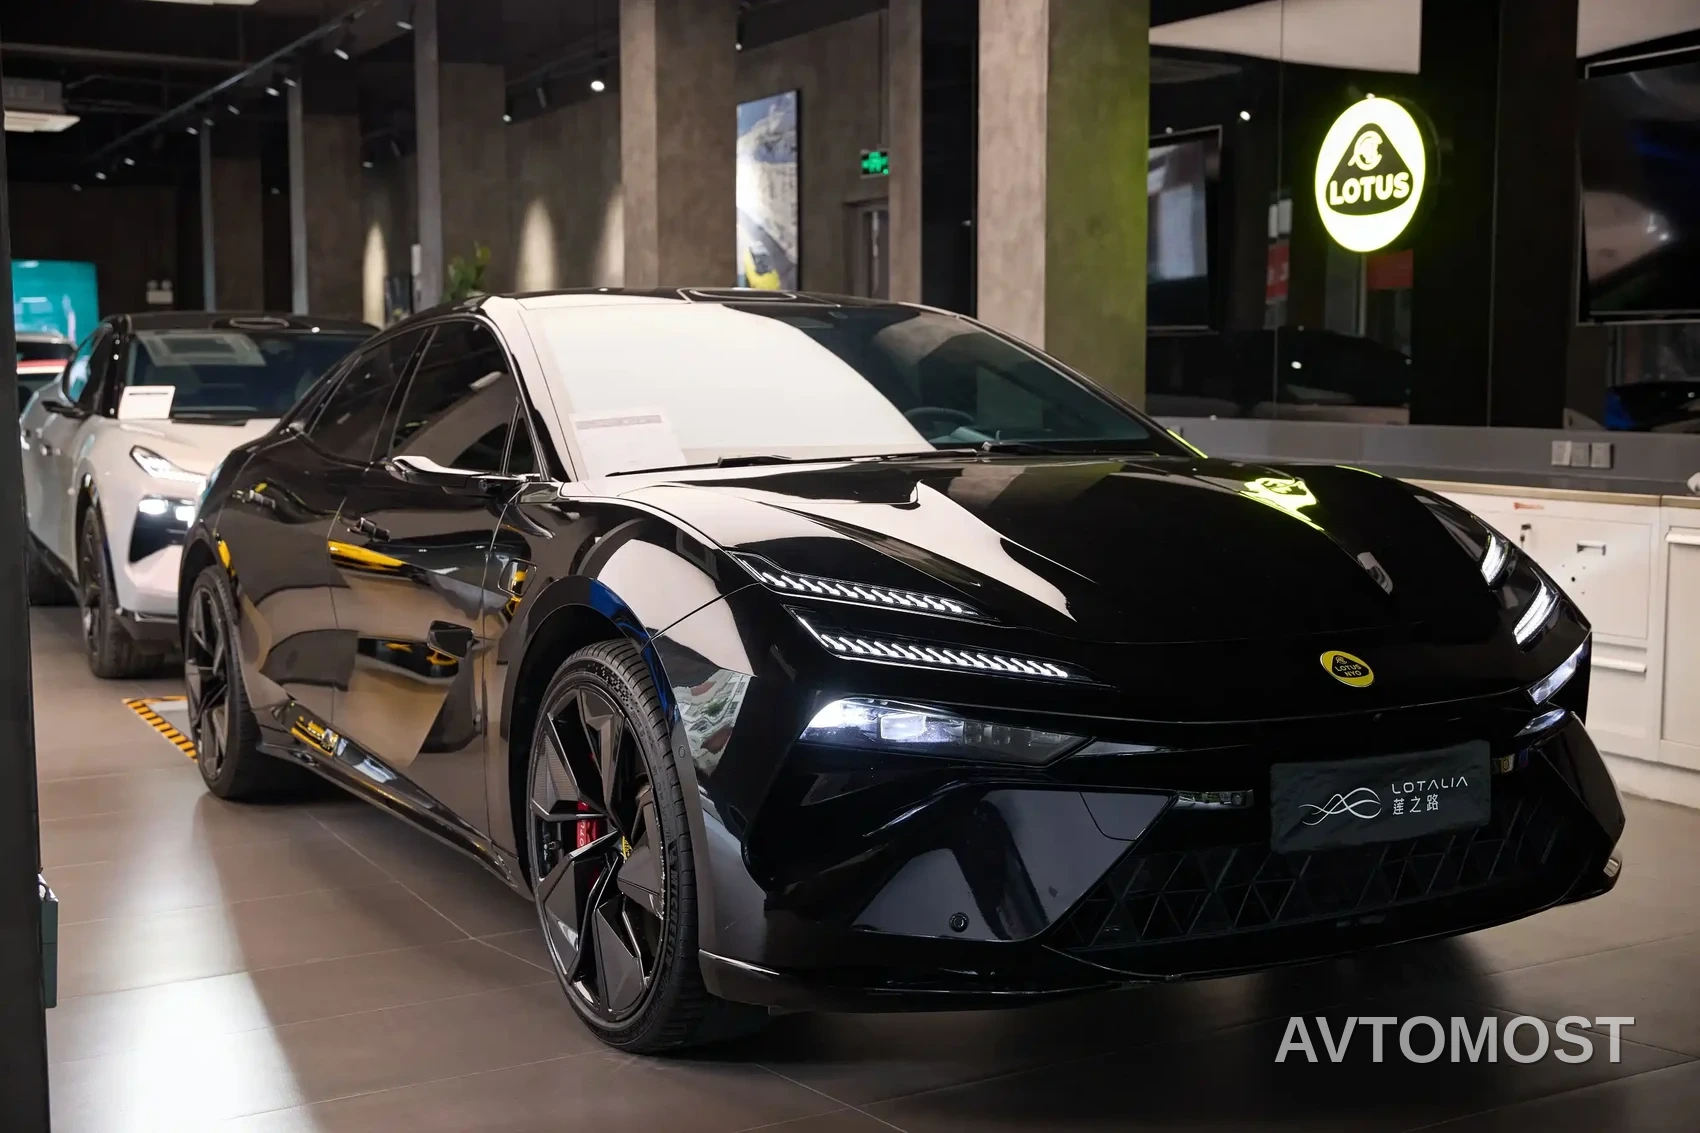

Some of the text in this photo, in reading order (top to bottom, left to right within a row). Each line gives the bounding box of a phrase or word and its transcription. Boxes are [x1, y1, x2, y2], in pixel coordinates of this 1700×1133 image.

[1329, 172, 1410, 206] LOTUS
[1334, 664, 1362, 672] LOTUS
[1391, 776, 1468, 795] LOTALIA
[1392, 793, 1439, 816] 莲之路
[665, 868, 679, 967] MICHELIN
